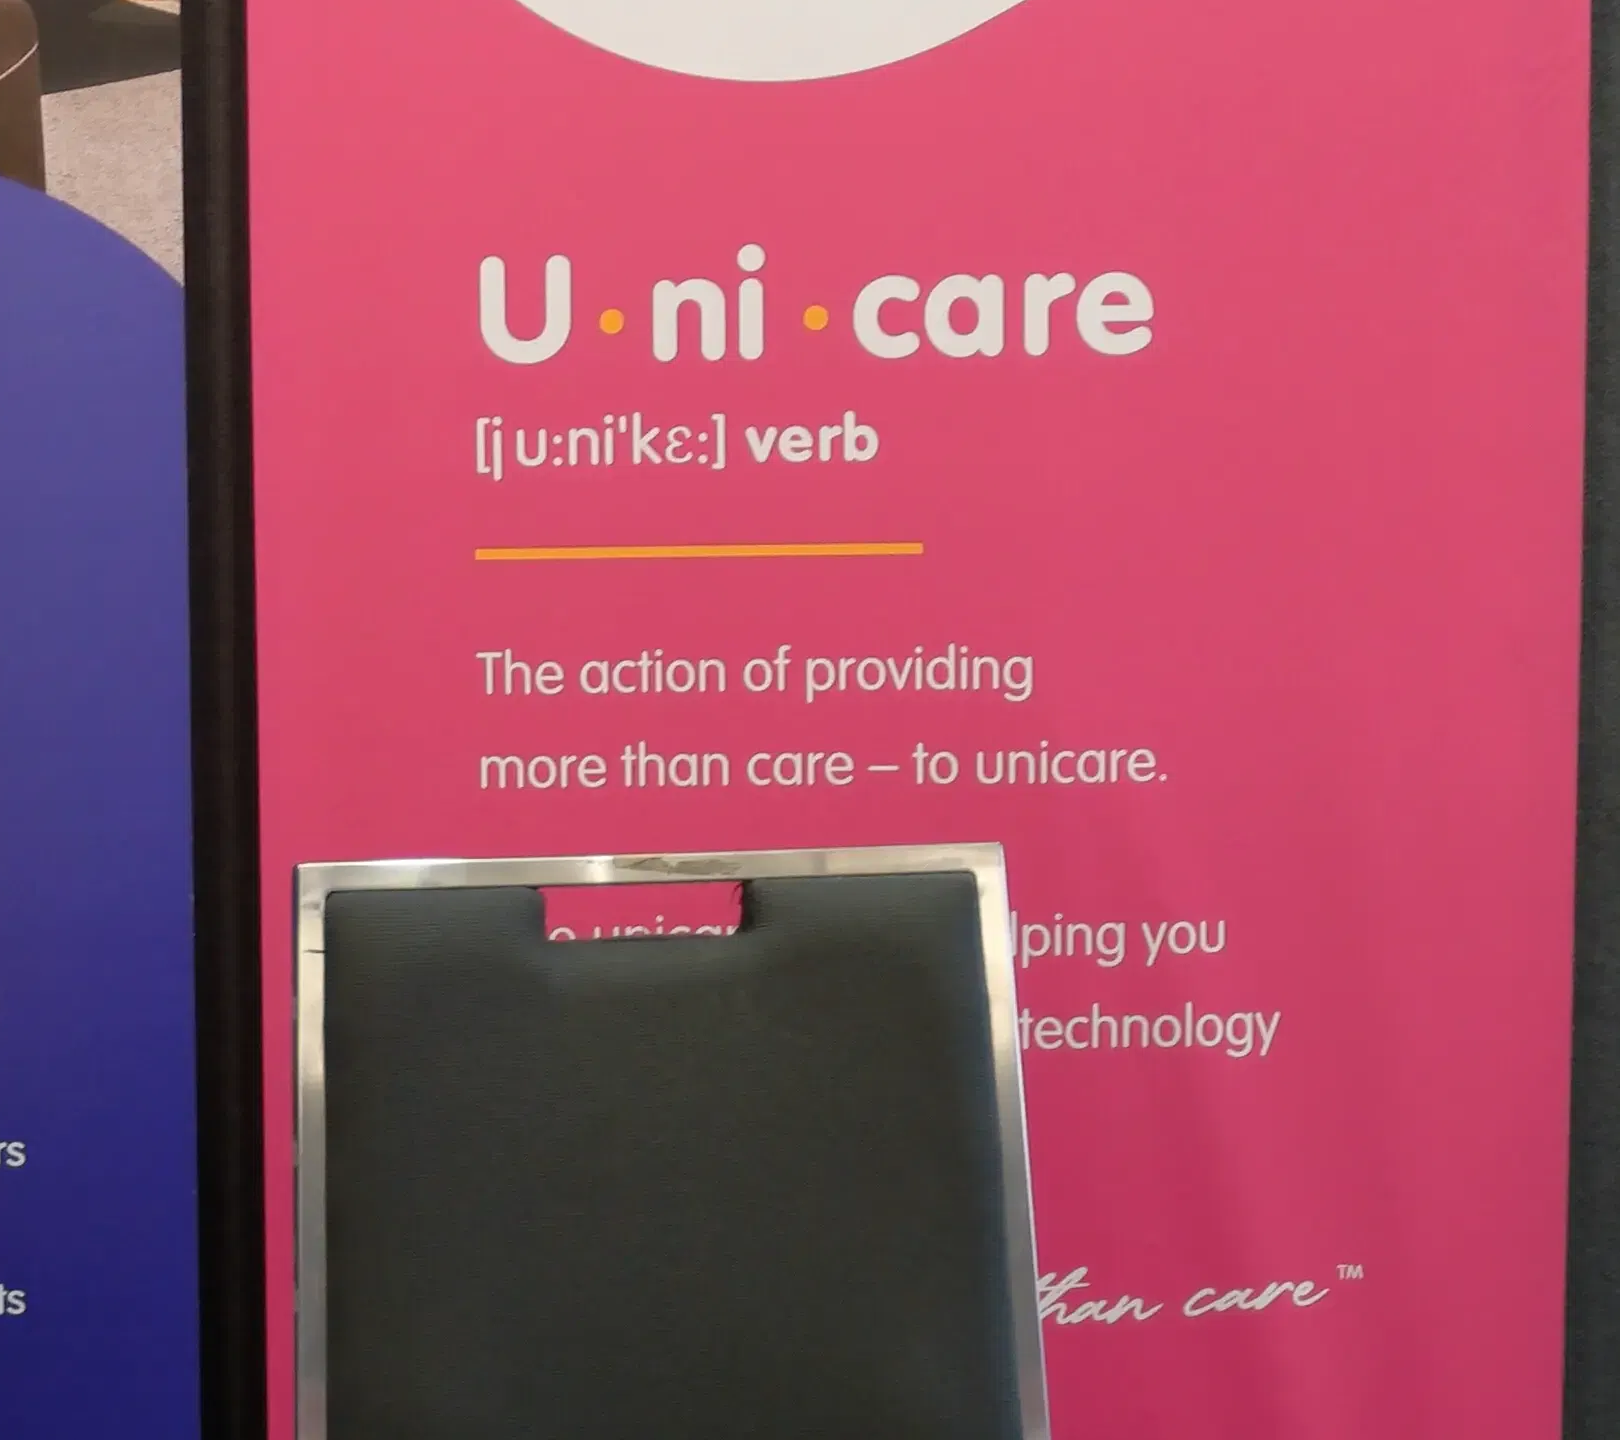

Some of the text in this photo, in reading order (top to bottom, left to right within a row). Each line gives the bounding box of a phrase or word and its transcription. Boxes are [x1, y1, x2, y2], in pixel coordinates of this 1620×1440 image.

[744, 410, 880, 466] verb
[475, 643, 1036, 704] The action of providing
[478, 751, 608, 791] more
[619, 742, 731, 789] than
[746, 748, 856, 788] care
[911, 745, 960, 787] to
[973, 738, 1169, 788] unicare.
[1141, 919, 1227, 968] you
[1017, 1000, 1282, 1059] technology
[1182, 1279, 1331, 1318] care
